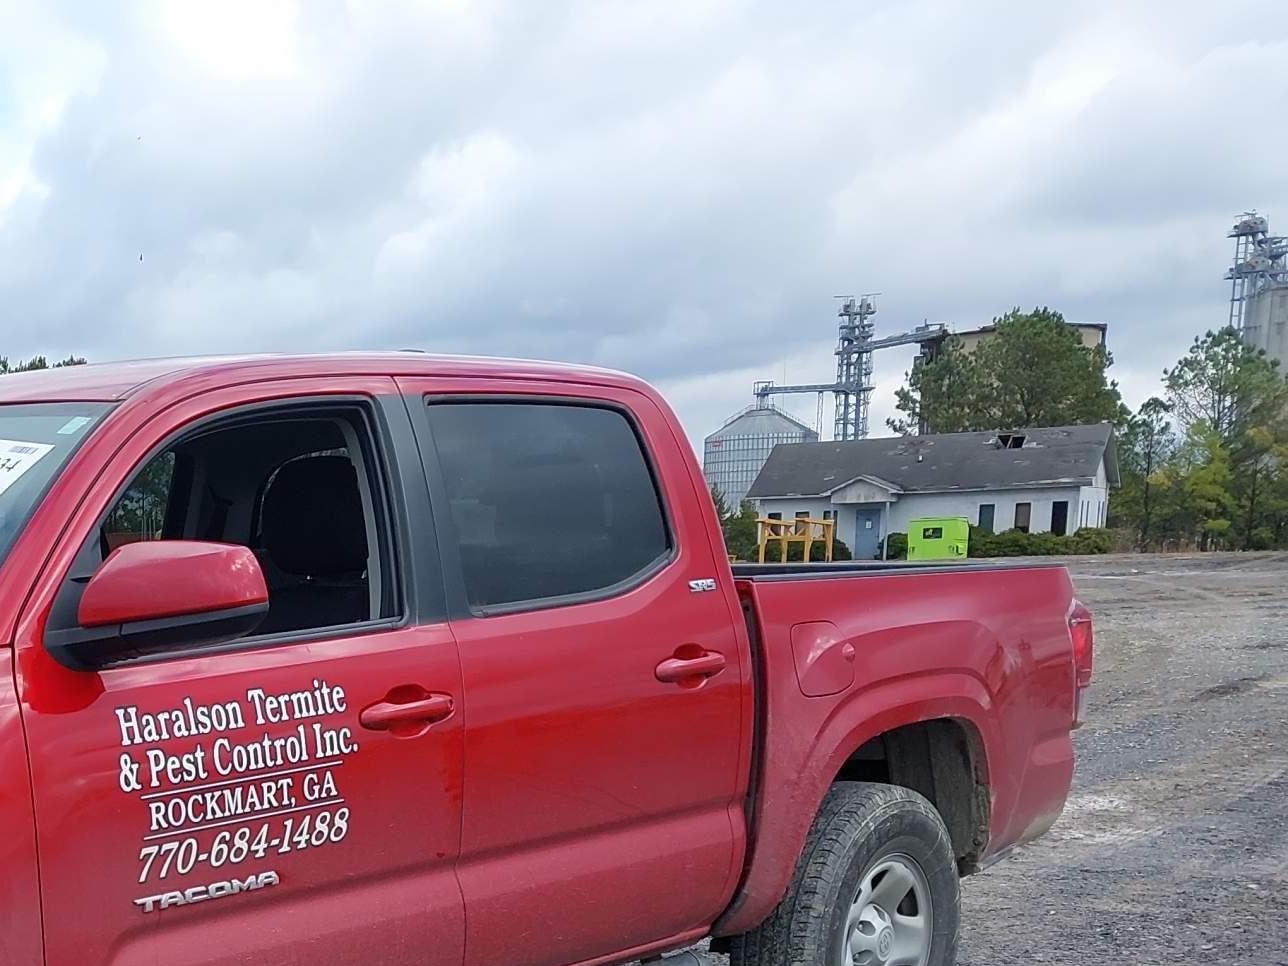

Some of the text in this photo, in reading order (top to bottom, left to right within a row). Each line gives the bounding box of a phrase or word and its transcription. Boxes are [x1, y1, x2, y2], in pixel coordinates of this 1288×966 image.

[116, 679, 347, 746] Haralson Termite
[119, 723, 358, 793] & Pest Control Inc.
[149, 771, 339, 831] ROCKMART, GA
[138, 807, 350, 883] 770-684-1488
[133, 870, 280, 913] TACOMA
